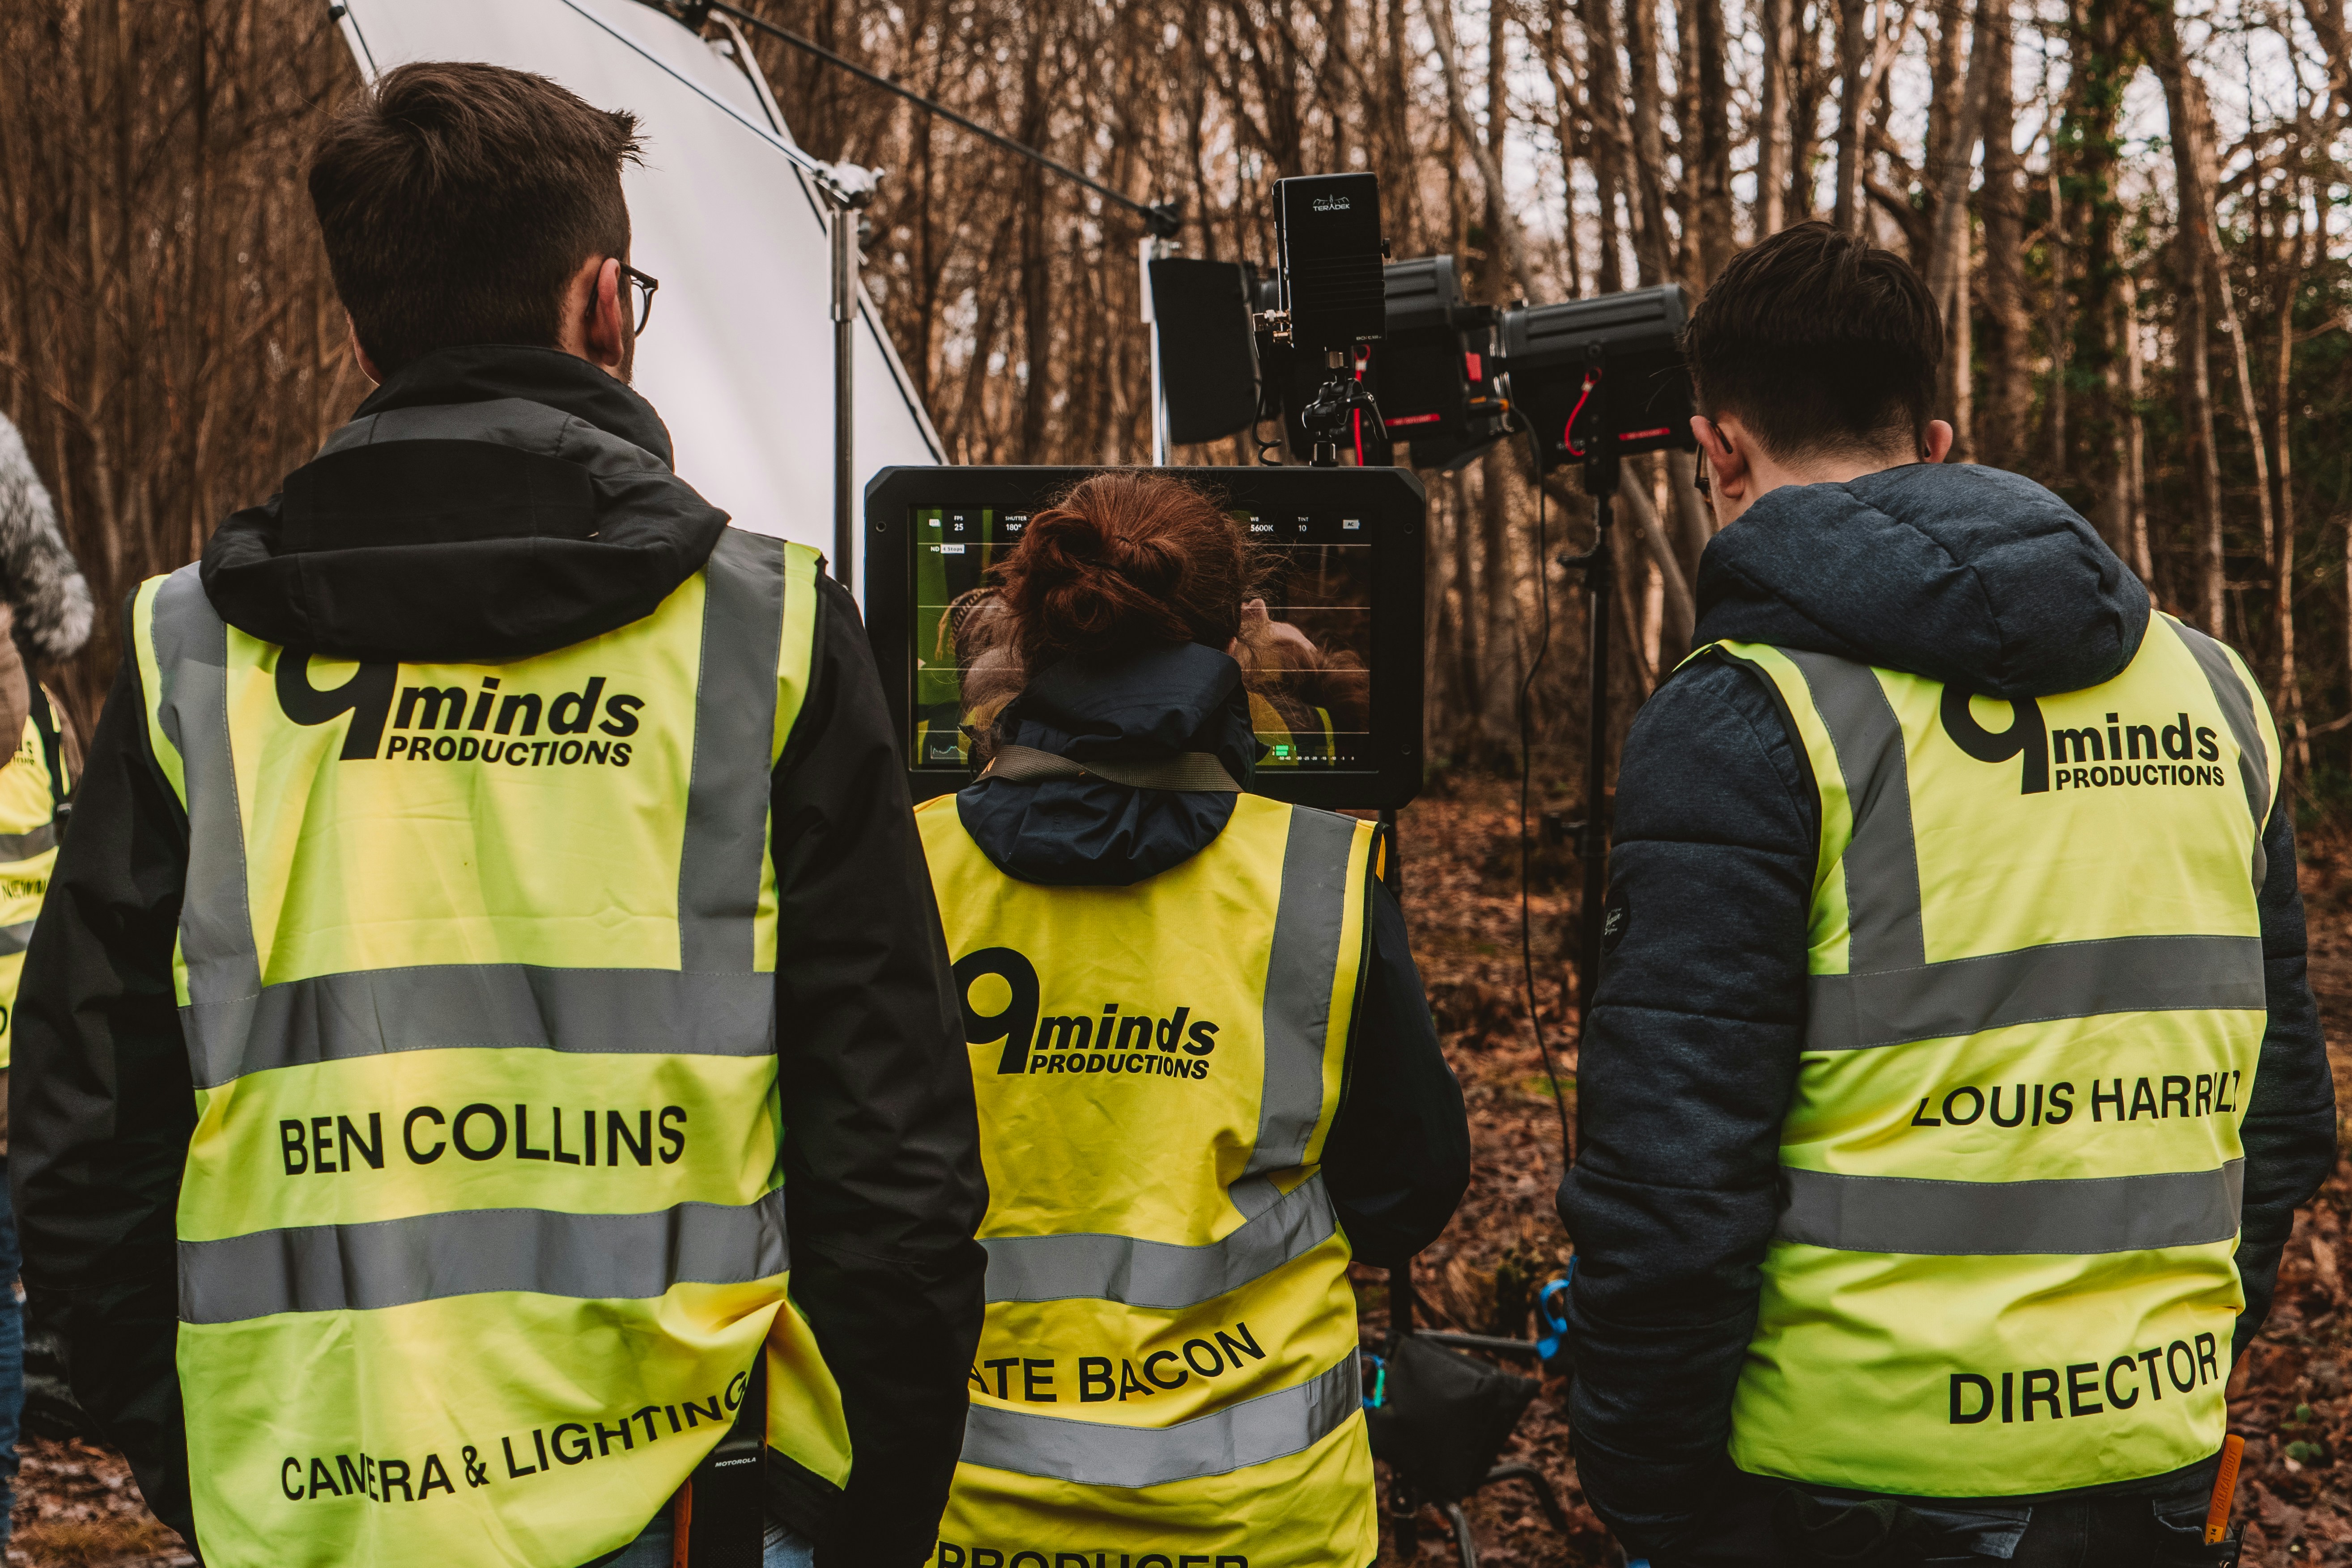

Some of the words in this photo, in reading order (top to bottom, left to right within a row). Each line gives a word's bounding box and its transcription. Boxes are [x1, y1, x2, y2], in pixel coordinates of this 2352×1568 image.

[1313, 204, 1350, 212] TERADEK
[1250, 524, 1274, 532] 5600K
[393, 676, 646, 737] minds
[386, 735, 633, 767] PRODUCTIONS
[2052, 712, 2219, 765] minds
[2056, 765, 2224, 791] PRODUCTIONS
[951, 947, 1040, 1075] 9
[1034, 1003, 1221, 1056] minds
[1029, 1053, 1210, 1080] PRODUCTIONS
[1910, 1081, 2075, 1128] LOUIS
[279, 1112, 384, 1176] BEN
[403, 1103, 688, 1167] COLLINS
[1078, 1321, 1267, 1403] BACON
[1949, 1331, 2219, 1424] DIRECTOR
[281, 1453, 456, 1503] CAMERA
[462, 1445, 490, 1488] &
[501, 1371, 746, 1479] LIGHTING
[715, 1457, 757, 1467] MOTOROLA
[2215, 1448, 2237, 1511] TALKABOUT
